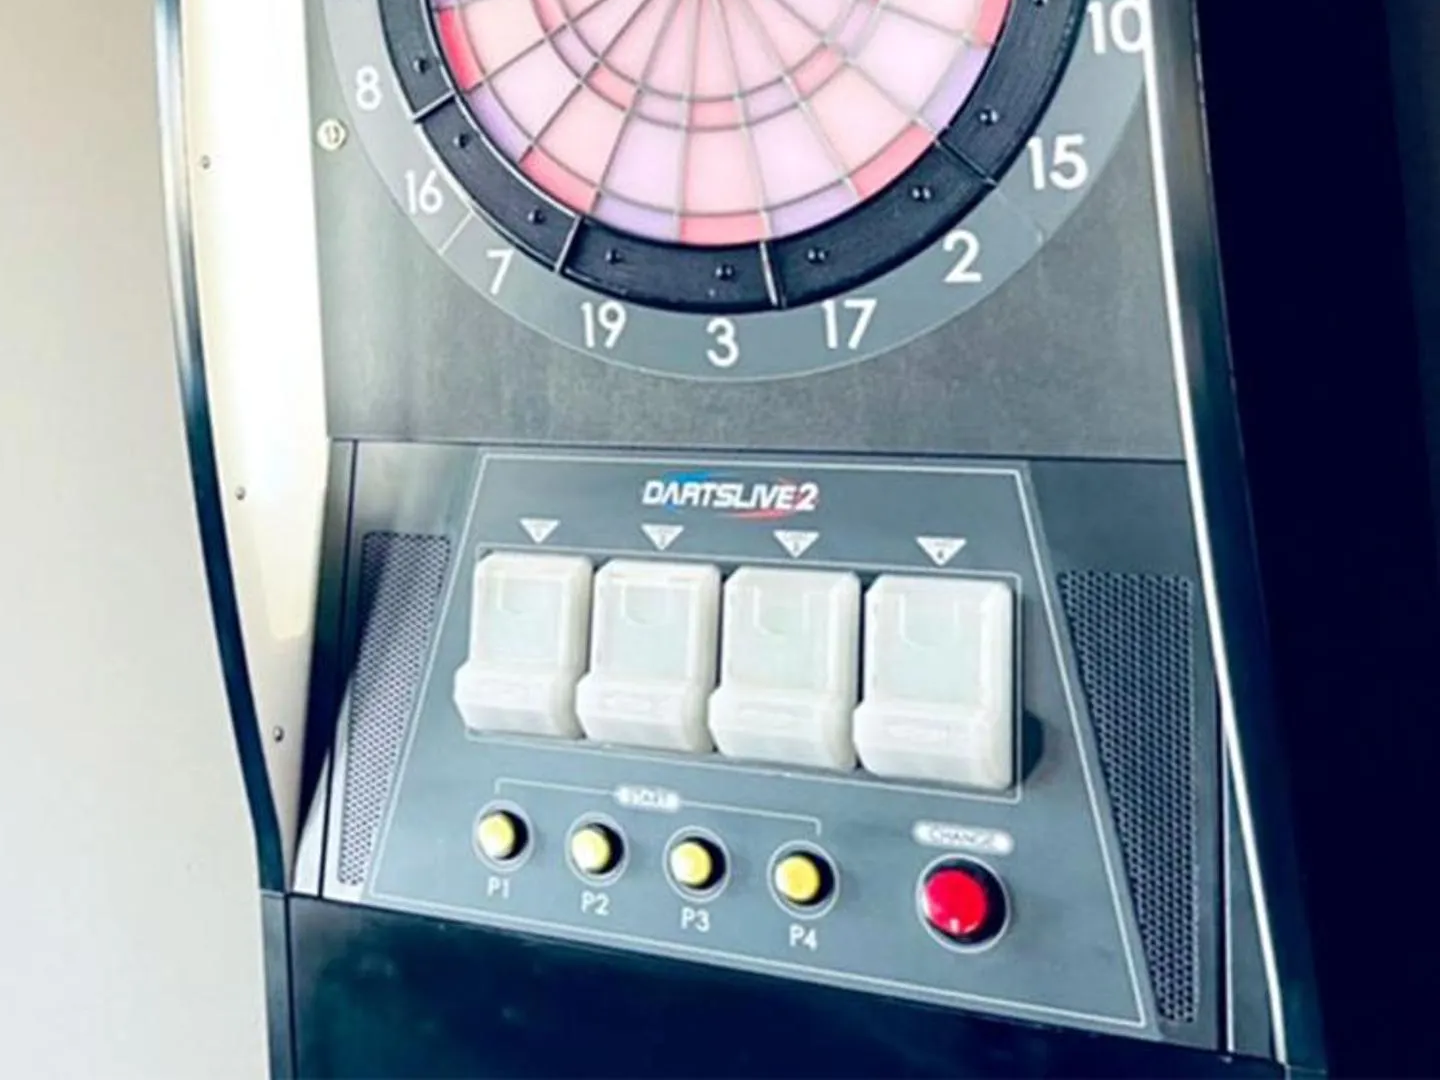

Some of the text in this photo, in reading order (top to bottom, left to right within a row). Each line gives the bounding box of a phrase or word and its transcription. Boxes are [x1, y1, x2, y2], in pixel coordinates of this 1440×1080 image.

[354, 64, 382, 111] 8
[1026, 133, 1090, 191] 15
[404, 169, 444, 215] 16
[486, 248, 514, 295] 7
[942, 229, 983, 284] 2
[580, 301, 627, 349] 19
[706, 317, 740, 367] 3
[821, 297, 878, 350] 17
[485, 876, 511, 900] P1
[580, 890, 610, 918] P2
[680, 907, 711, 933] P3
[789, 925, 819, 953] P4
